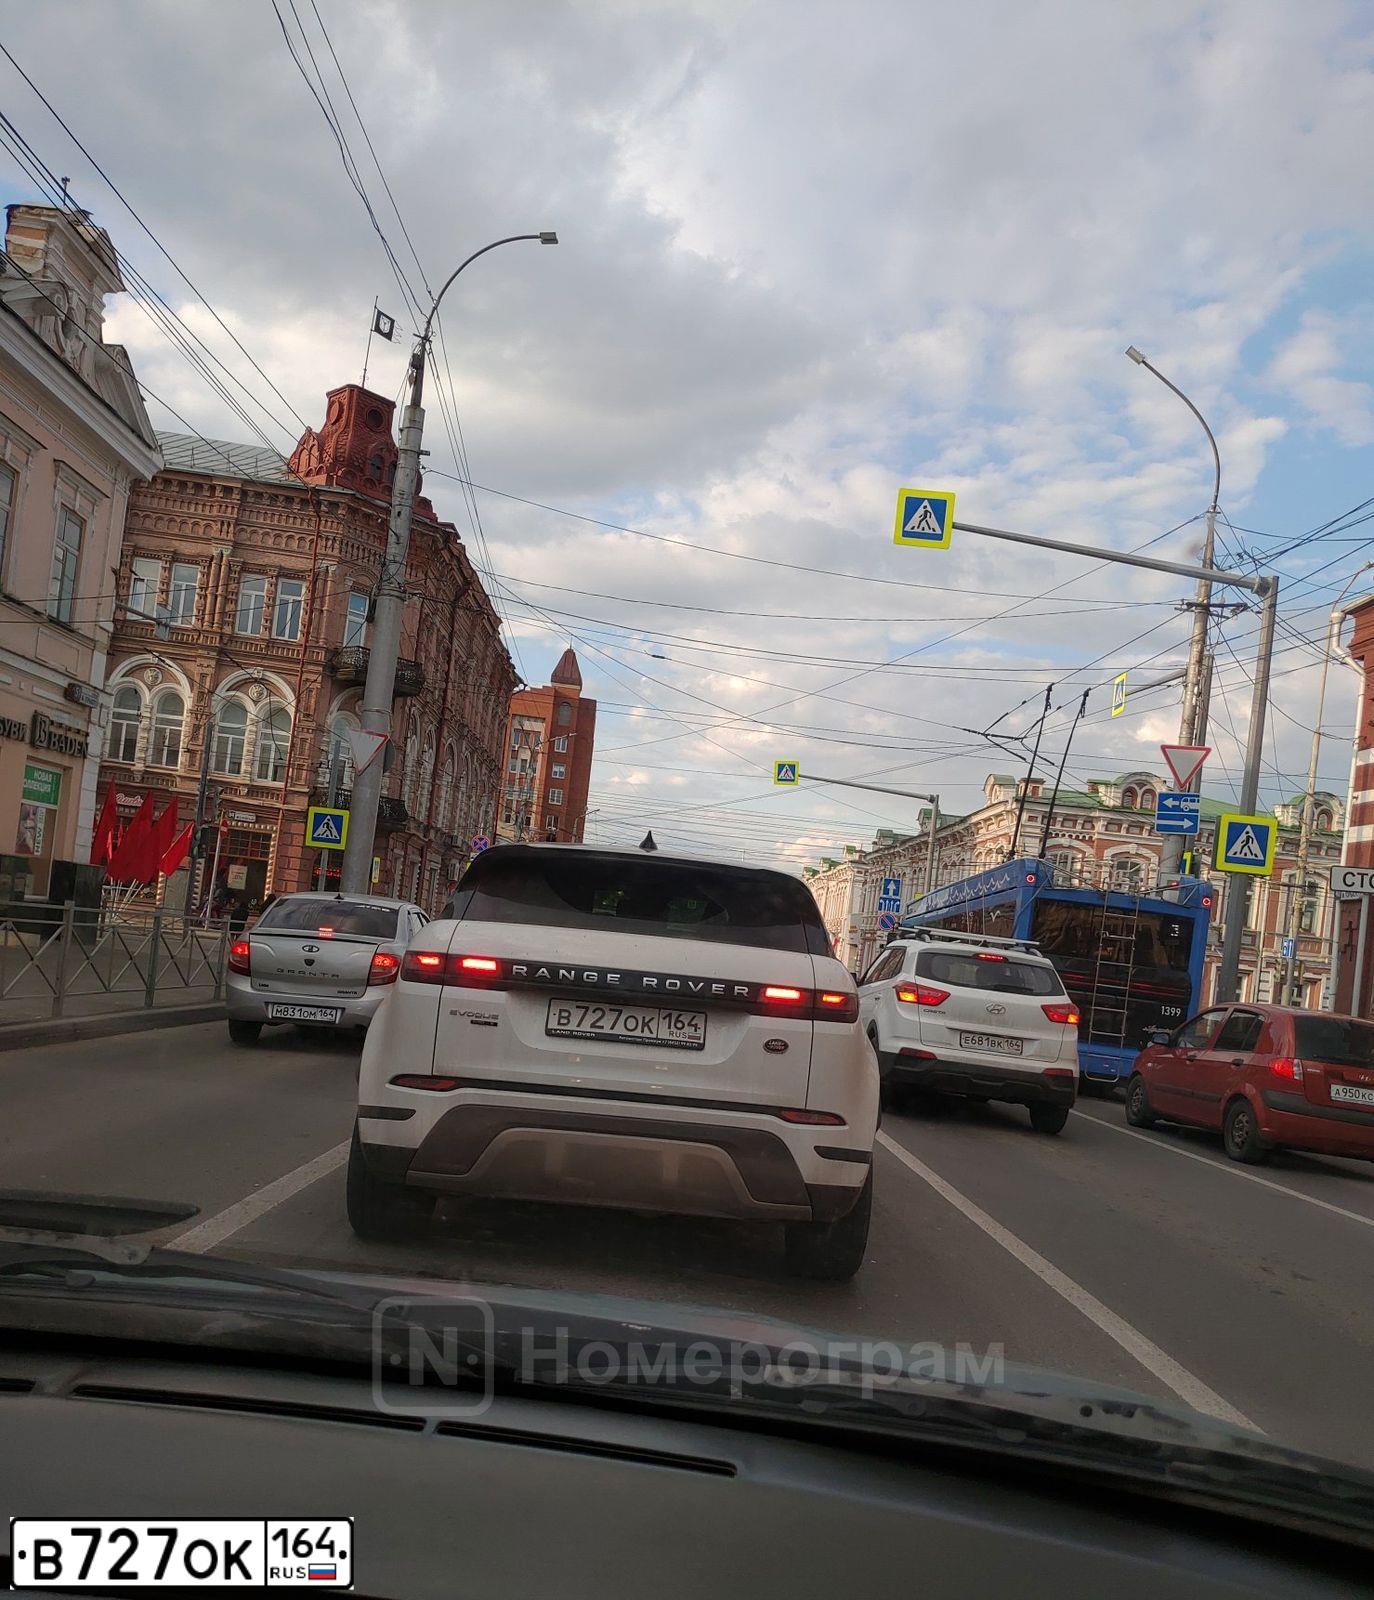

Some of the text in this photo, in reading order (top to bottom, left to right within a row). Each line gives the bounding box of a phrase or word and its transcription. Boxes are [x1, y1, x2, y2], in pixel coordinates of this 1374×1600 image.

[50, 731, 88, 757] BADEN
[512, 964, 749, 997] RANGE ROVER
[275, 1007, 334, 1019] М831ОМ 164
[449, 1009, 500, 1020] EVOQUE
[1161, 1005, 1181, 1018] 1399
[556, 1005, 700, 1035] В727ОК 164
[668, 1030, 688, 1040] RUS
[964, 1035, 1020, 1049] Е681ВК 164
[1334, 1087, 1374, 1101] А950КС
